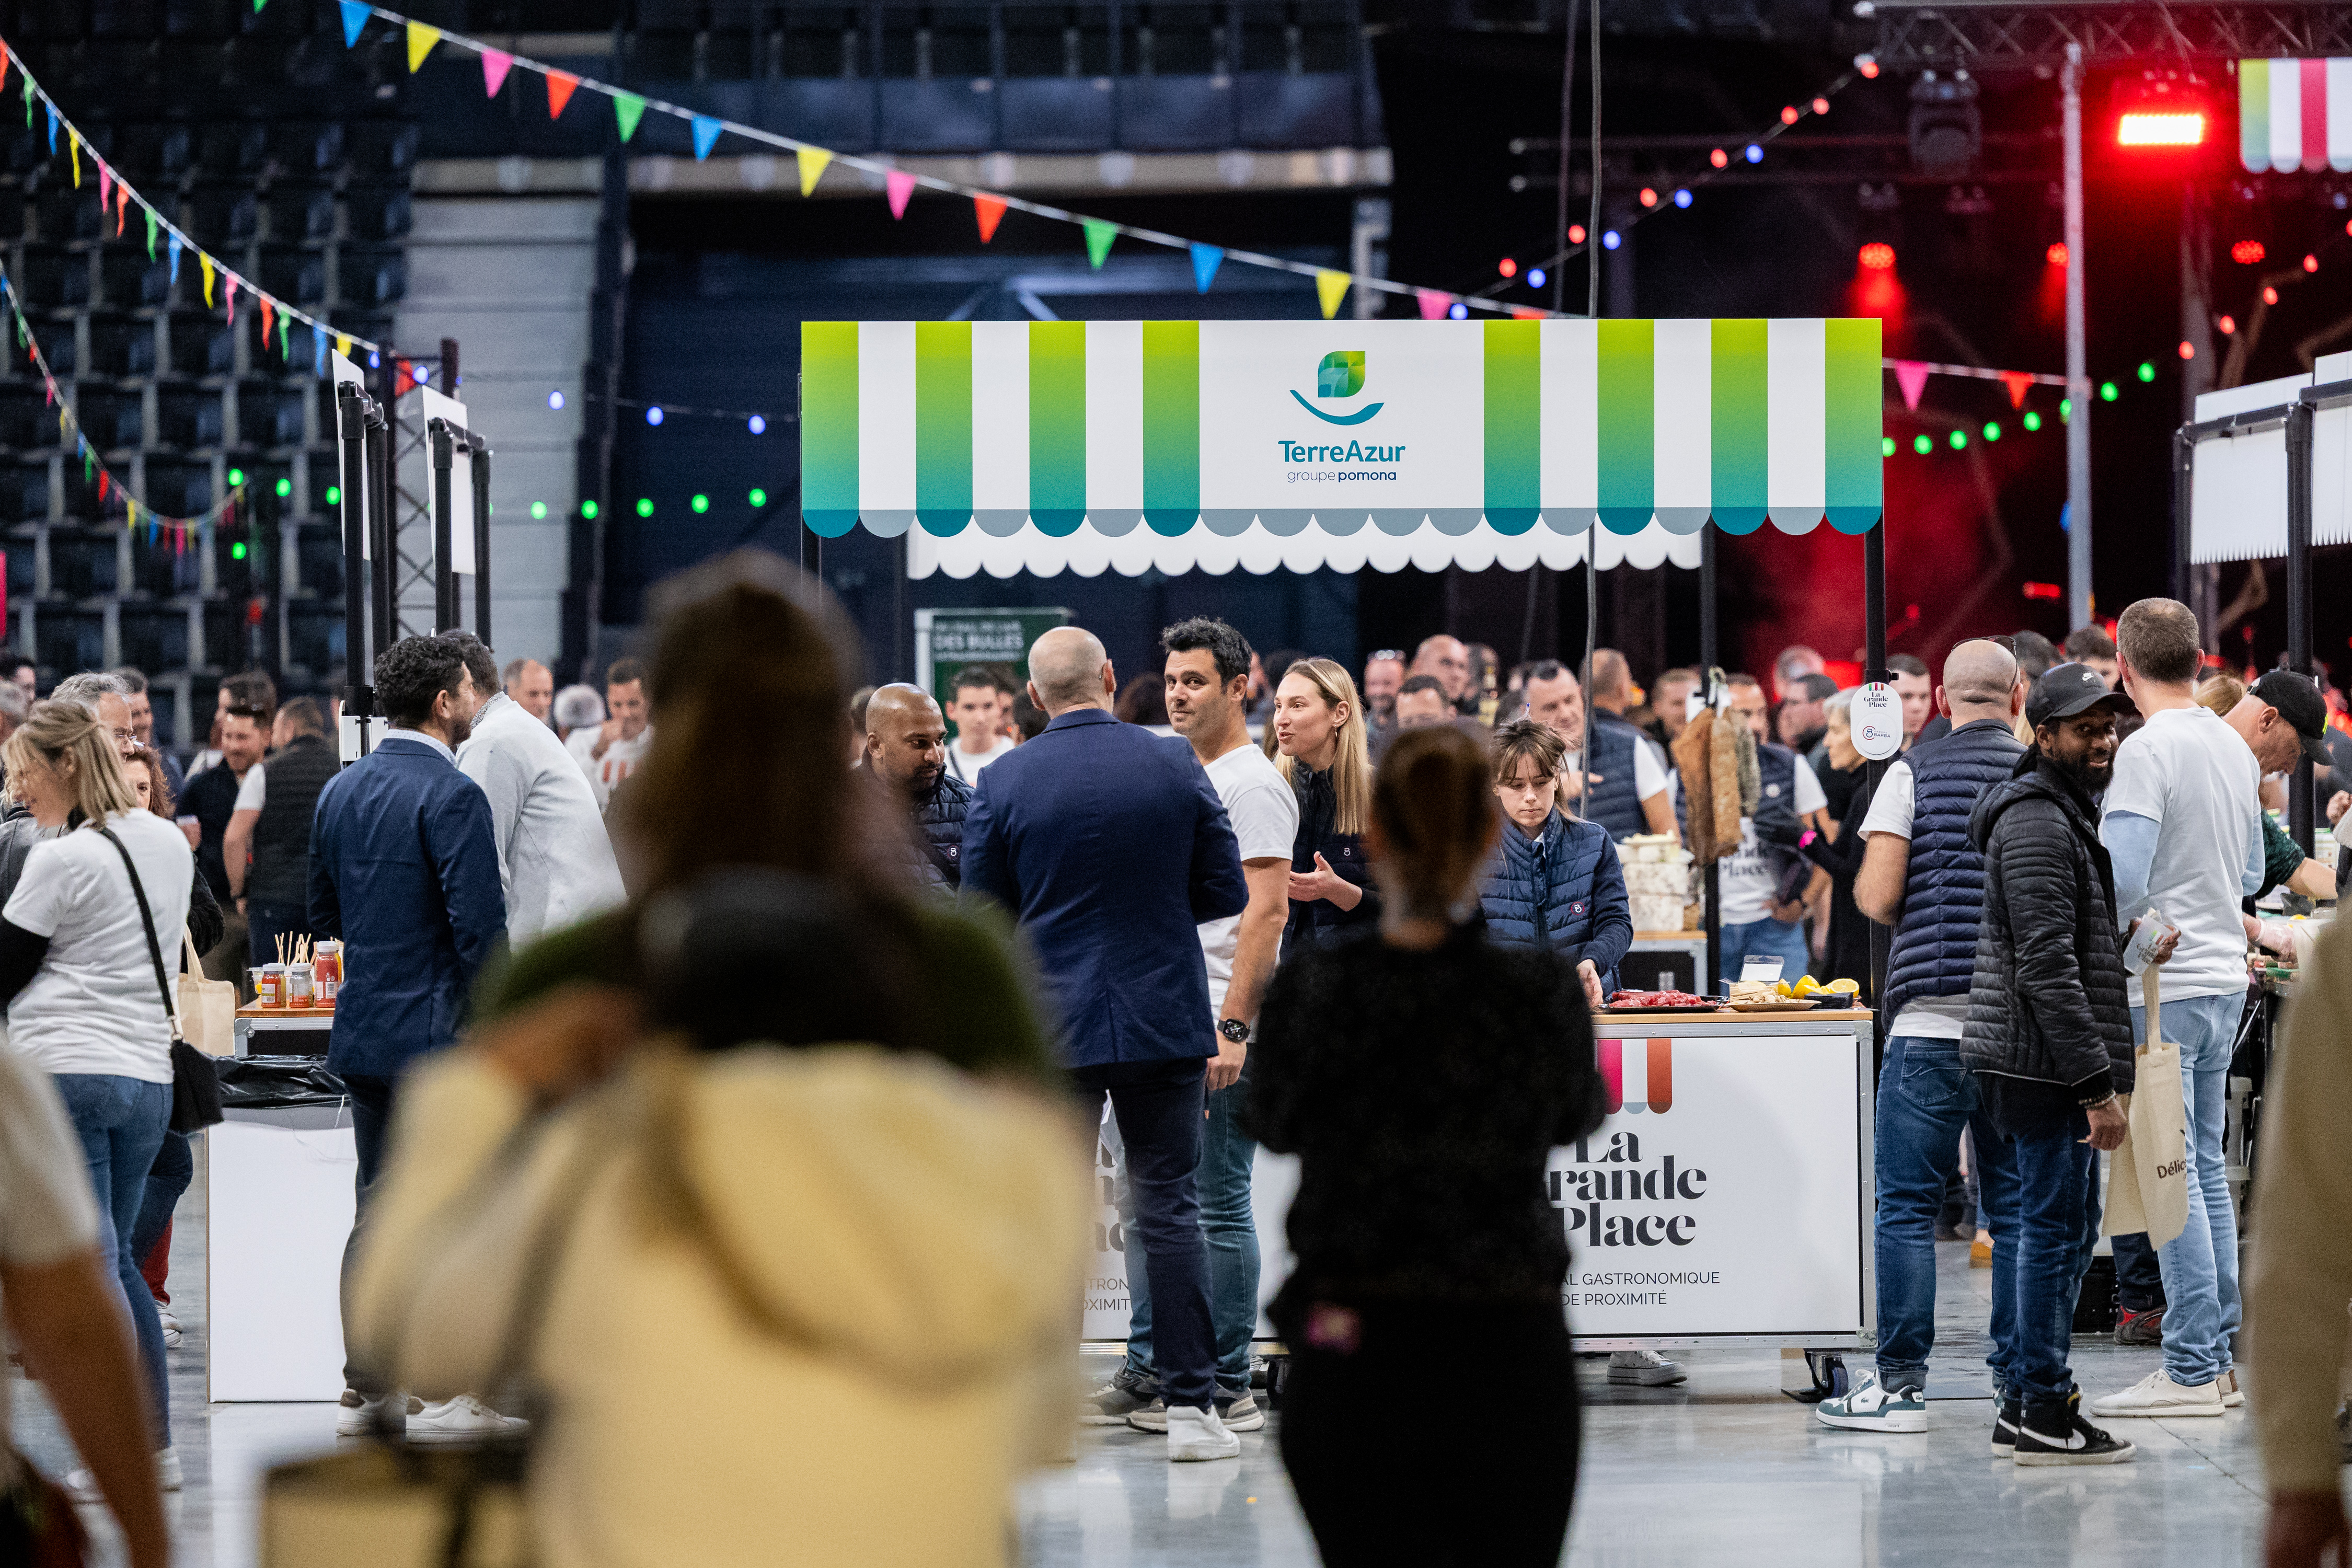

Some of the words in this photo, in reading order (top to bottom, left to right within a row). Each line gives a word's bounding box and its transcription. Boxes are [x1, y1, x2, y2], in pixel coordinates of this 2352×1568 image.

[1278, 440, 1406, 463] TerreAzur
[1287, 472, 1335, 483] groupe
[1338, 471, 1396, 482] pomona
[1572, 1132, 1644, 1163] La
[1547, 1155, 1707, 1201] rande
[1583, 1272, 1720, 1285] GASTRONOMIQUE
[1585, 1289, 1667, 1306] PROXIMITÉ
